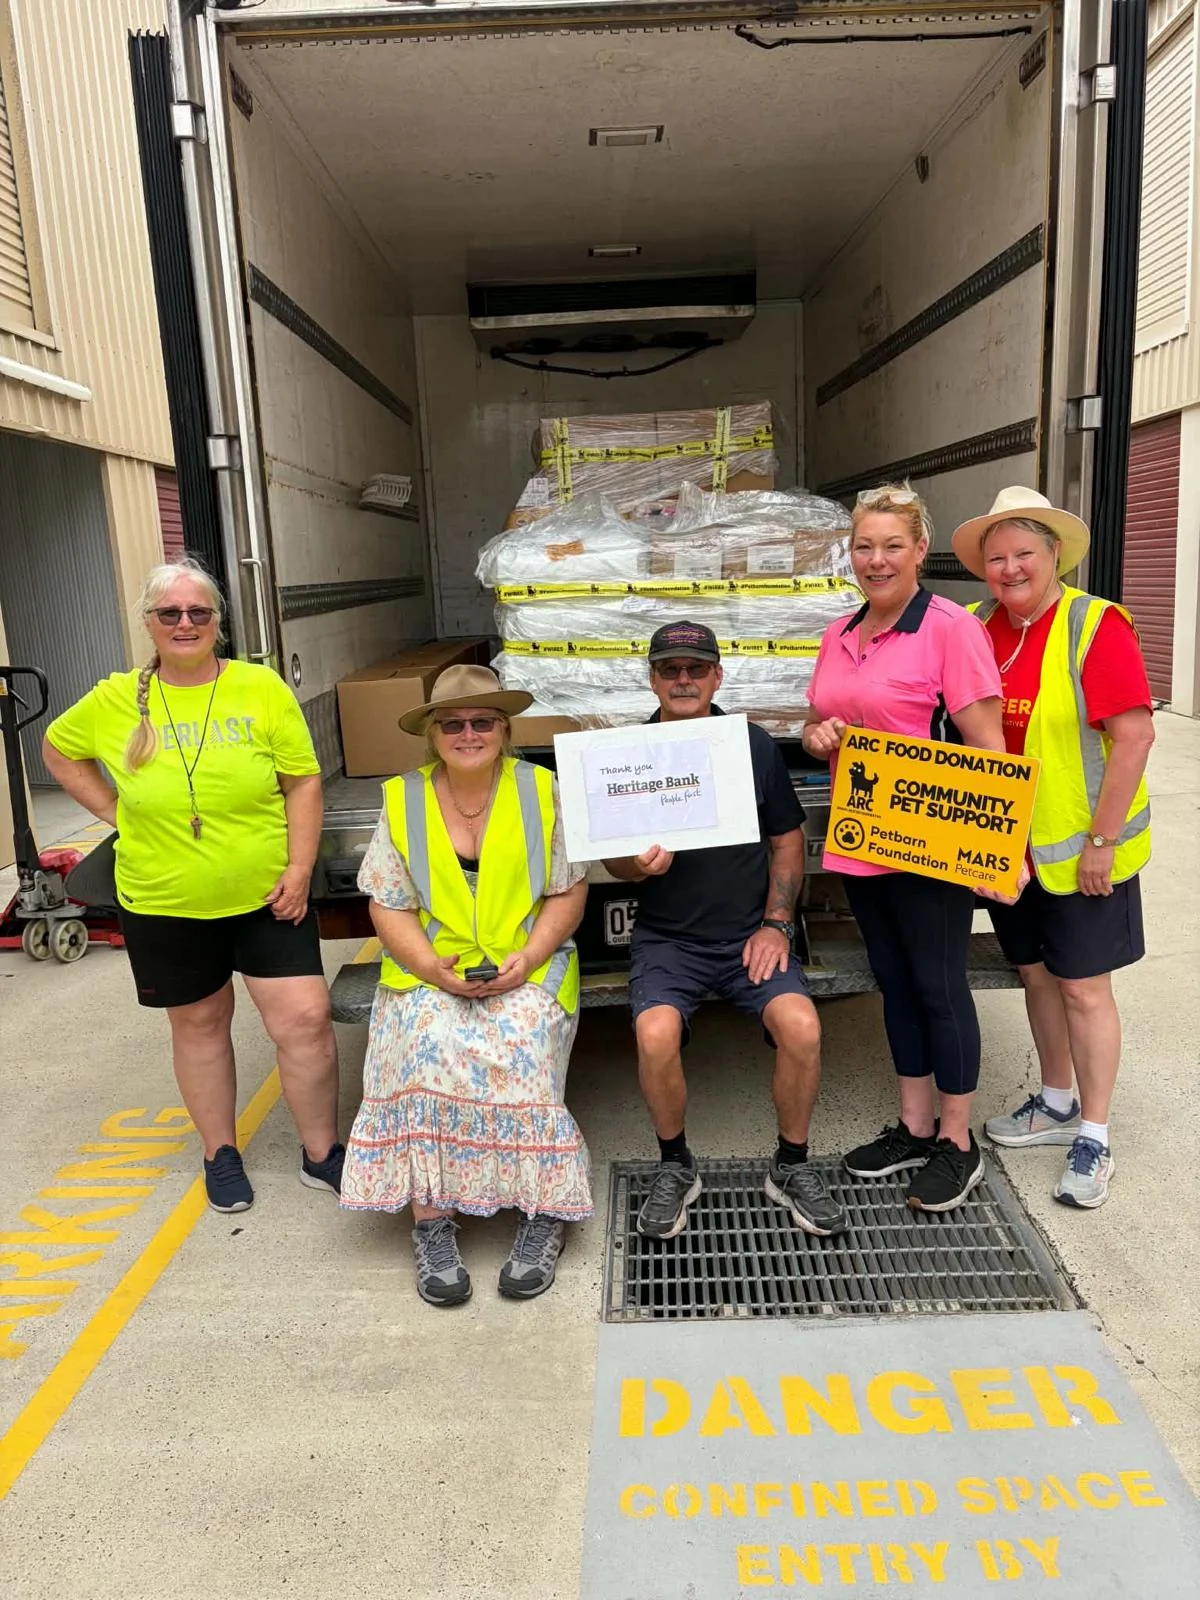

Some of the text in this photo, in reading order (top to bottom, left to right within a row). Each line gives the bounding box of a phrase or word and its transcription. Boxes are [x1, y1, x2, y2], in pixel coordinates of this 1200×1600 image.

[1002, 698, 1032, 715] ER
[162, 716, 256, 750] ERLAST
[599, 763, 653, 776] Thank you
[846, 734, 1032, 781] ARC FOOD DONATION
[606, 772, 700, 795] Heritage Bank
[894, 778, 1015, 816] COMMUNITY
[846, 795, 874, 812] ARC
[889, 794, 925, 815] PET
[926, 802, 1018, 835] SUPPORT
[870, 826, 927, 849] Petbarn
[868, 842, 949, 871] Foundation
[956, 847, 1010, 873] MARS
[955, 864, 997, 882] Petcare
[618, 1365, 1123, 1438] DANGER
[619, 1470, 1167, 1519] CONFINED SPACE
[736, 1536, 1062, 1586] ENTRY BY
